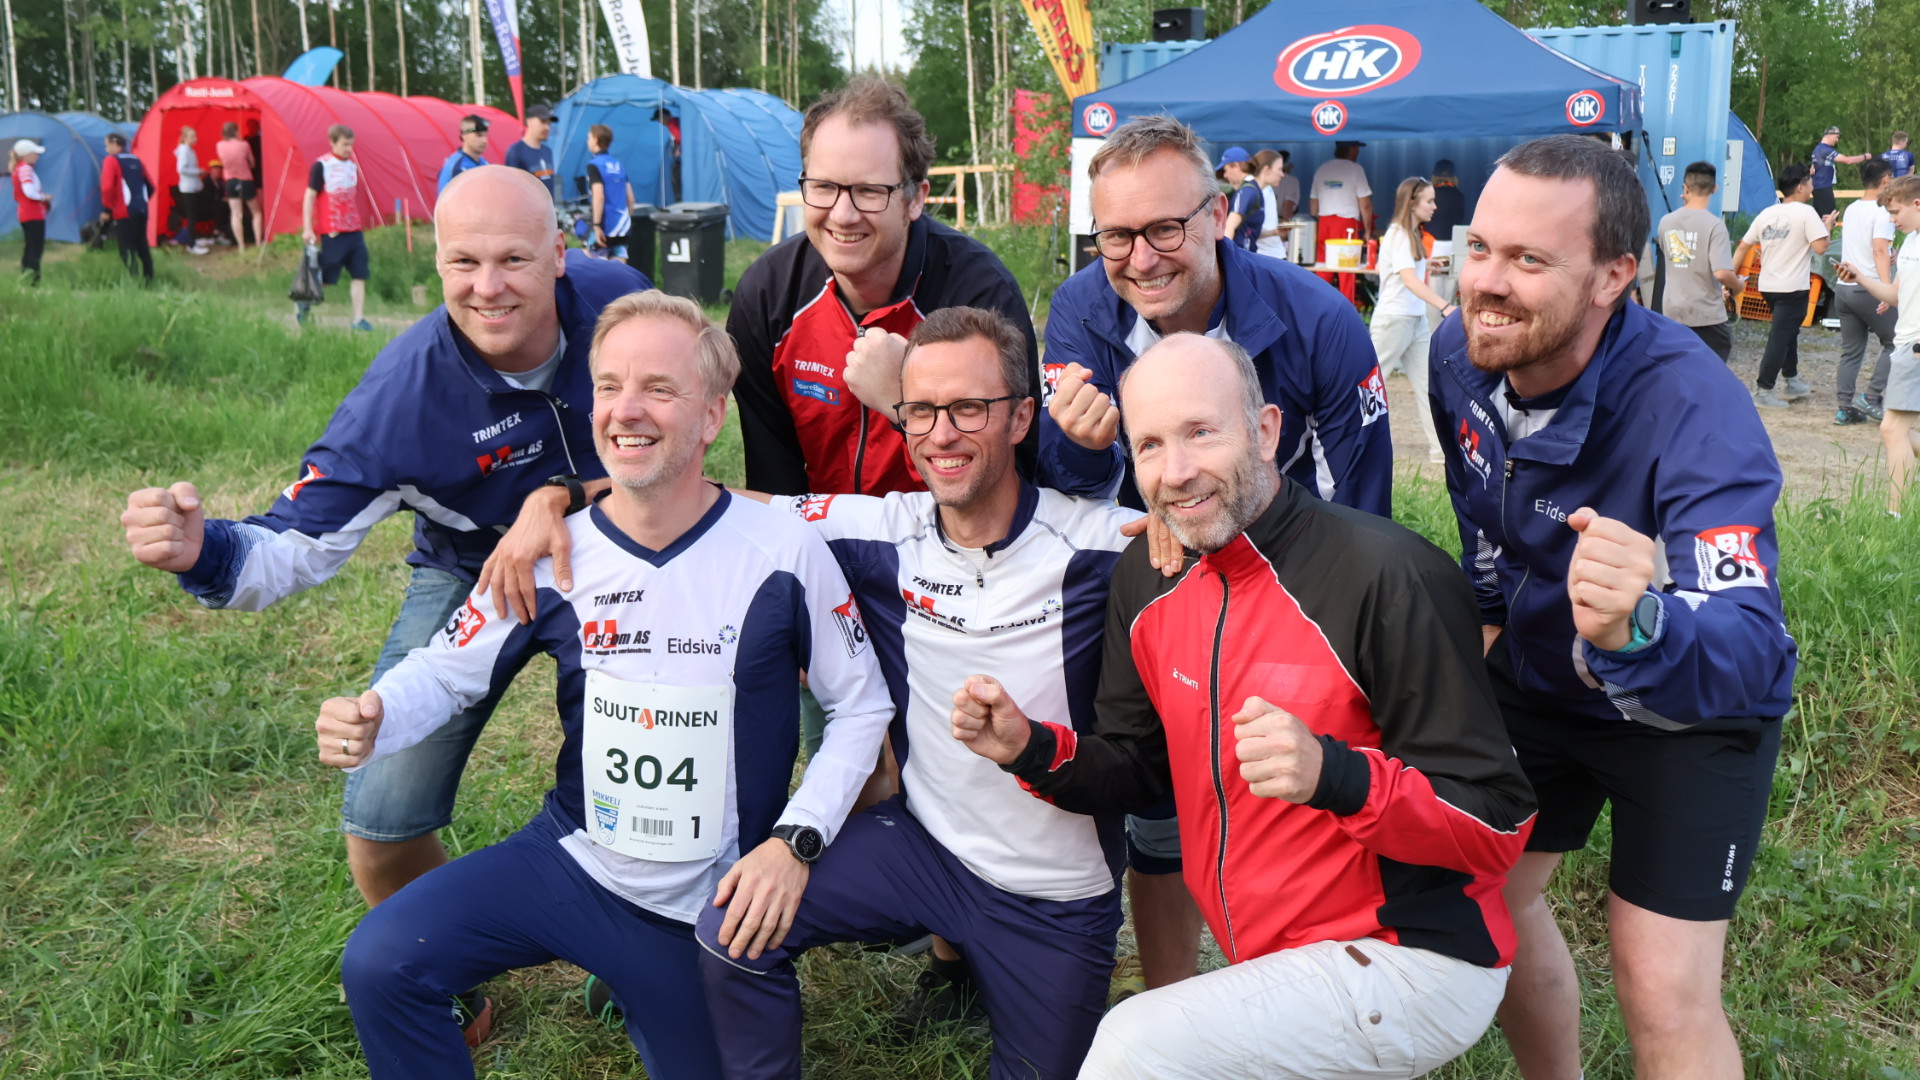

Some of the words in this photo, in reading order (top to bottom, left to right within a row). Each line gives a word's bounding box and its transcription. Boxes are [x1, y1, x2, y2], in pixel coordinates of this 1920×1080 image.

[1303, 47, 1390, 81] HK
[1319, 110, 1339, 125] HK
[1574, 100, 1596, 117] HK
[1089, 111, 1109, 127] HK
[793, 359, 835, 378] TRIMTEX
[472, 411, 522, 444] TRIMTEX
[911, 575, 964, 597] TRIMTEX
[594, 589, 645, 608] TRIMTEX
[632, 630, 651, 645] AS
[667, 637, 722, 656] Eidsiva
[593, 696, 719, 730] SUUTARINEN
[605, 747, 699, 792] 304
[592, 789, 621, 807] MIKKELI
[691, 815, 701, 840] 1
[1724, 844, 1737, 878] SWECO
